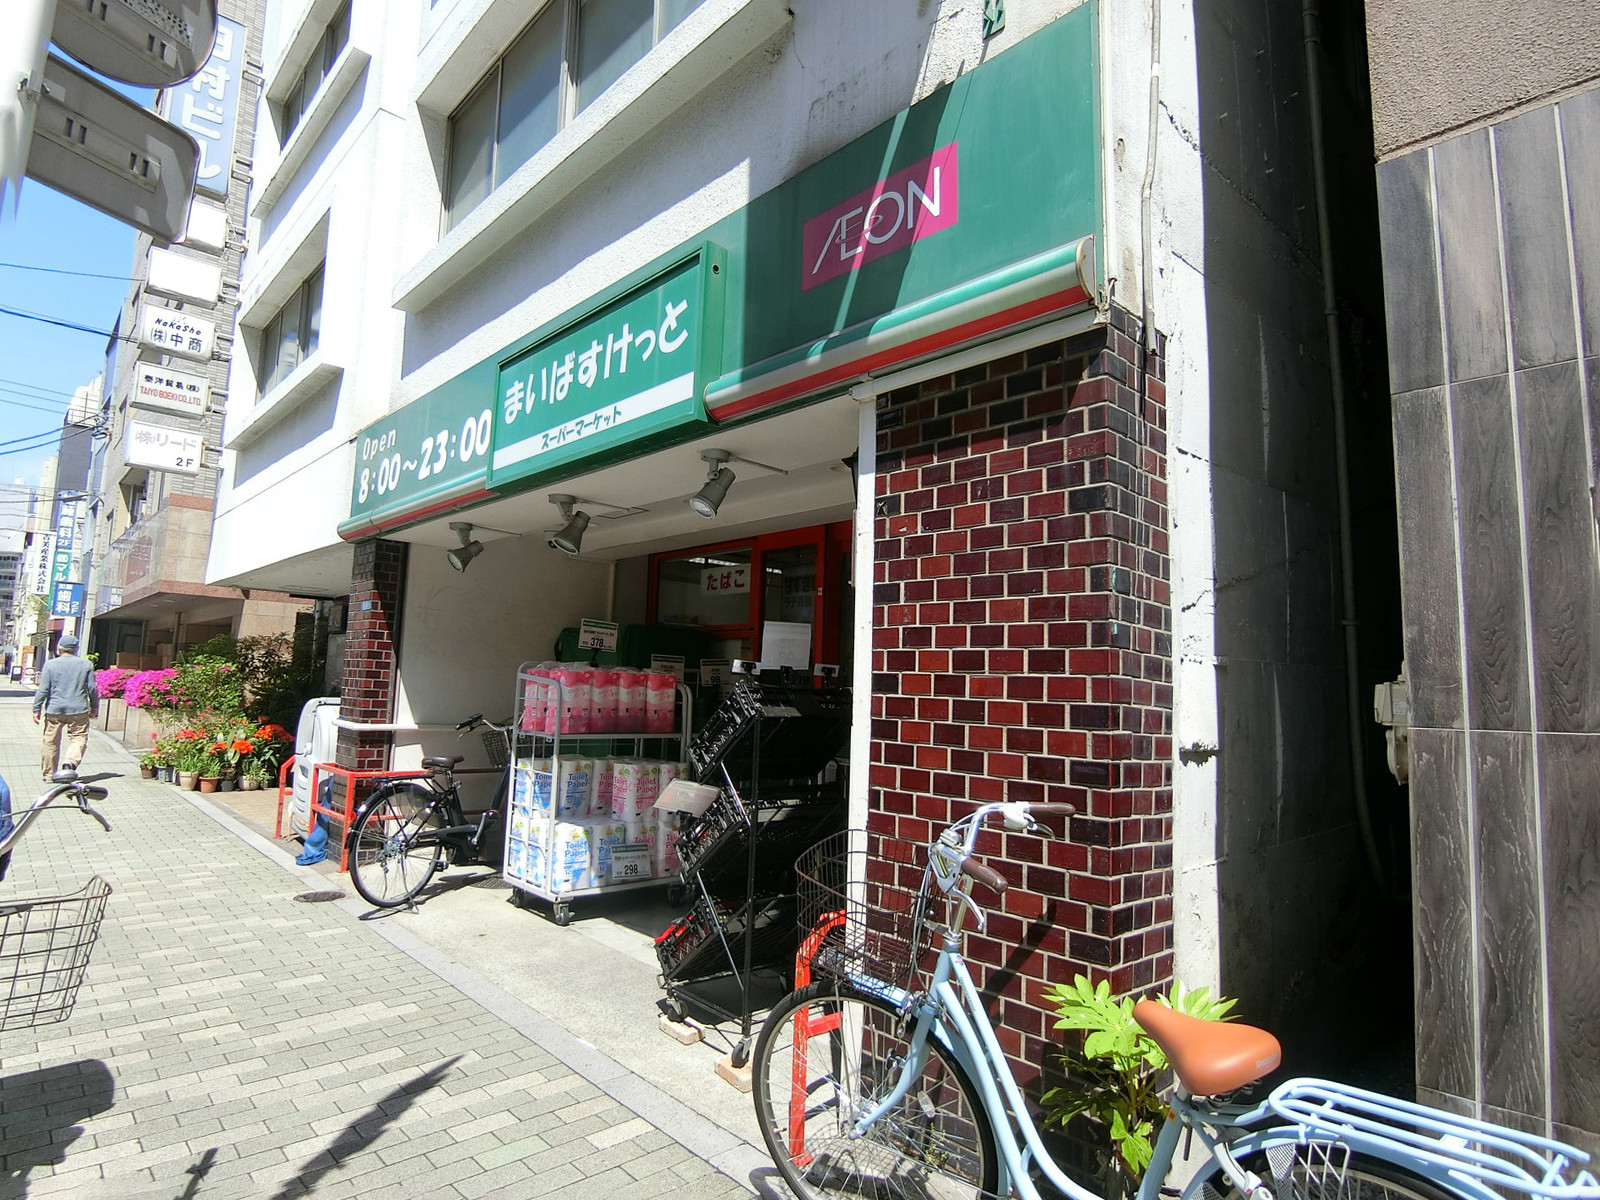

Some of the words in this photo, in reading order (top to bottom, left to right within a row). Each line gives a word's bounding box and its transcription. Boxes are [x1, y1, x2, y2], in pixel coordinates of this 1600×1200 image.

[504, 298, 690, 425] まいばすけっと
[541, 405, 622, 450] スーパーマーケット
[362, 428, 397, 461] Open
[176, 457, 194, 468] 2F
[706, 569, 746, 592] たばこ
[590, 637, 604, 647] 378
[568, 773, 589, 781] Toilet
[636, 777, 657, 785] Toilet
[567, 780, 589, 788] Paper
[636, 785, 657, 793] Paper
[565, 840, 588, 849] Toilet
[599, 837, 620, 846] Toilet
[564, 849, 588, 858] Paper
[623, 863, 639, 875] 298
